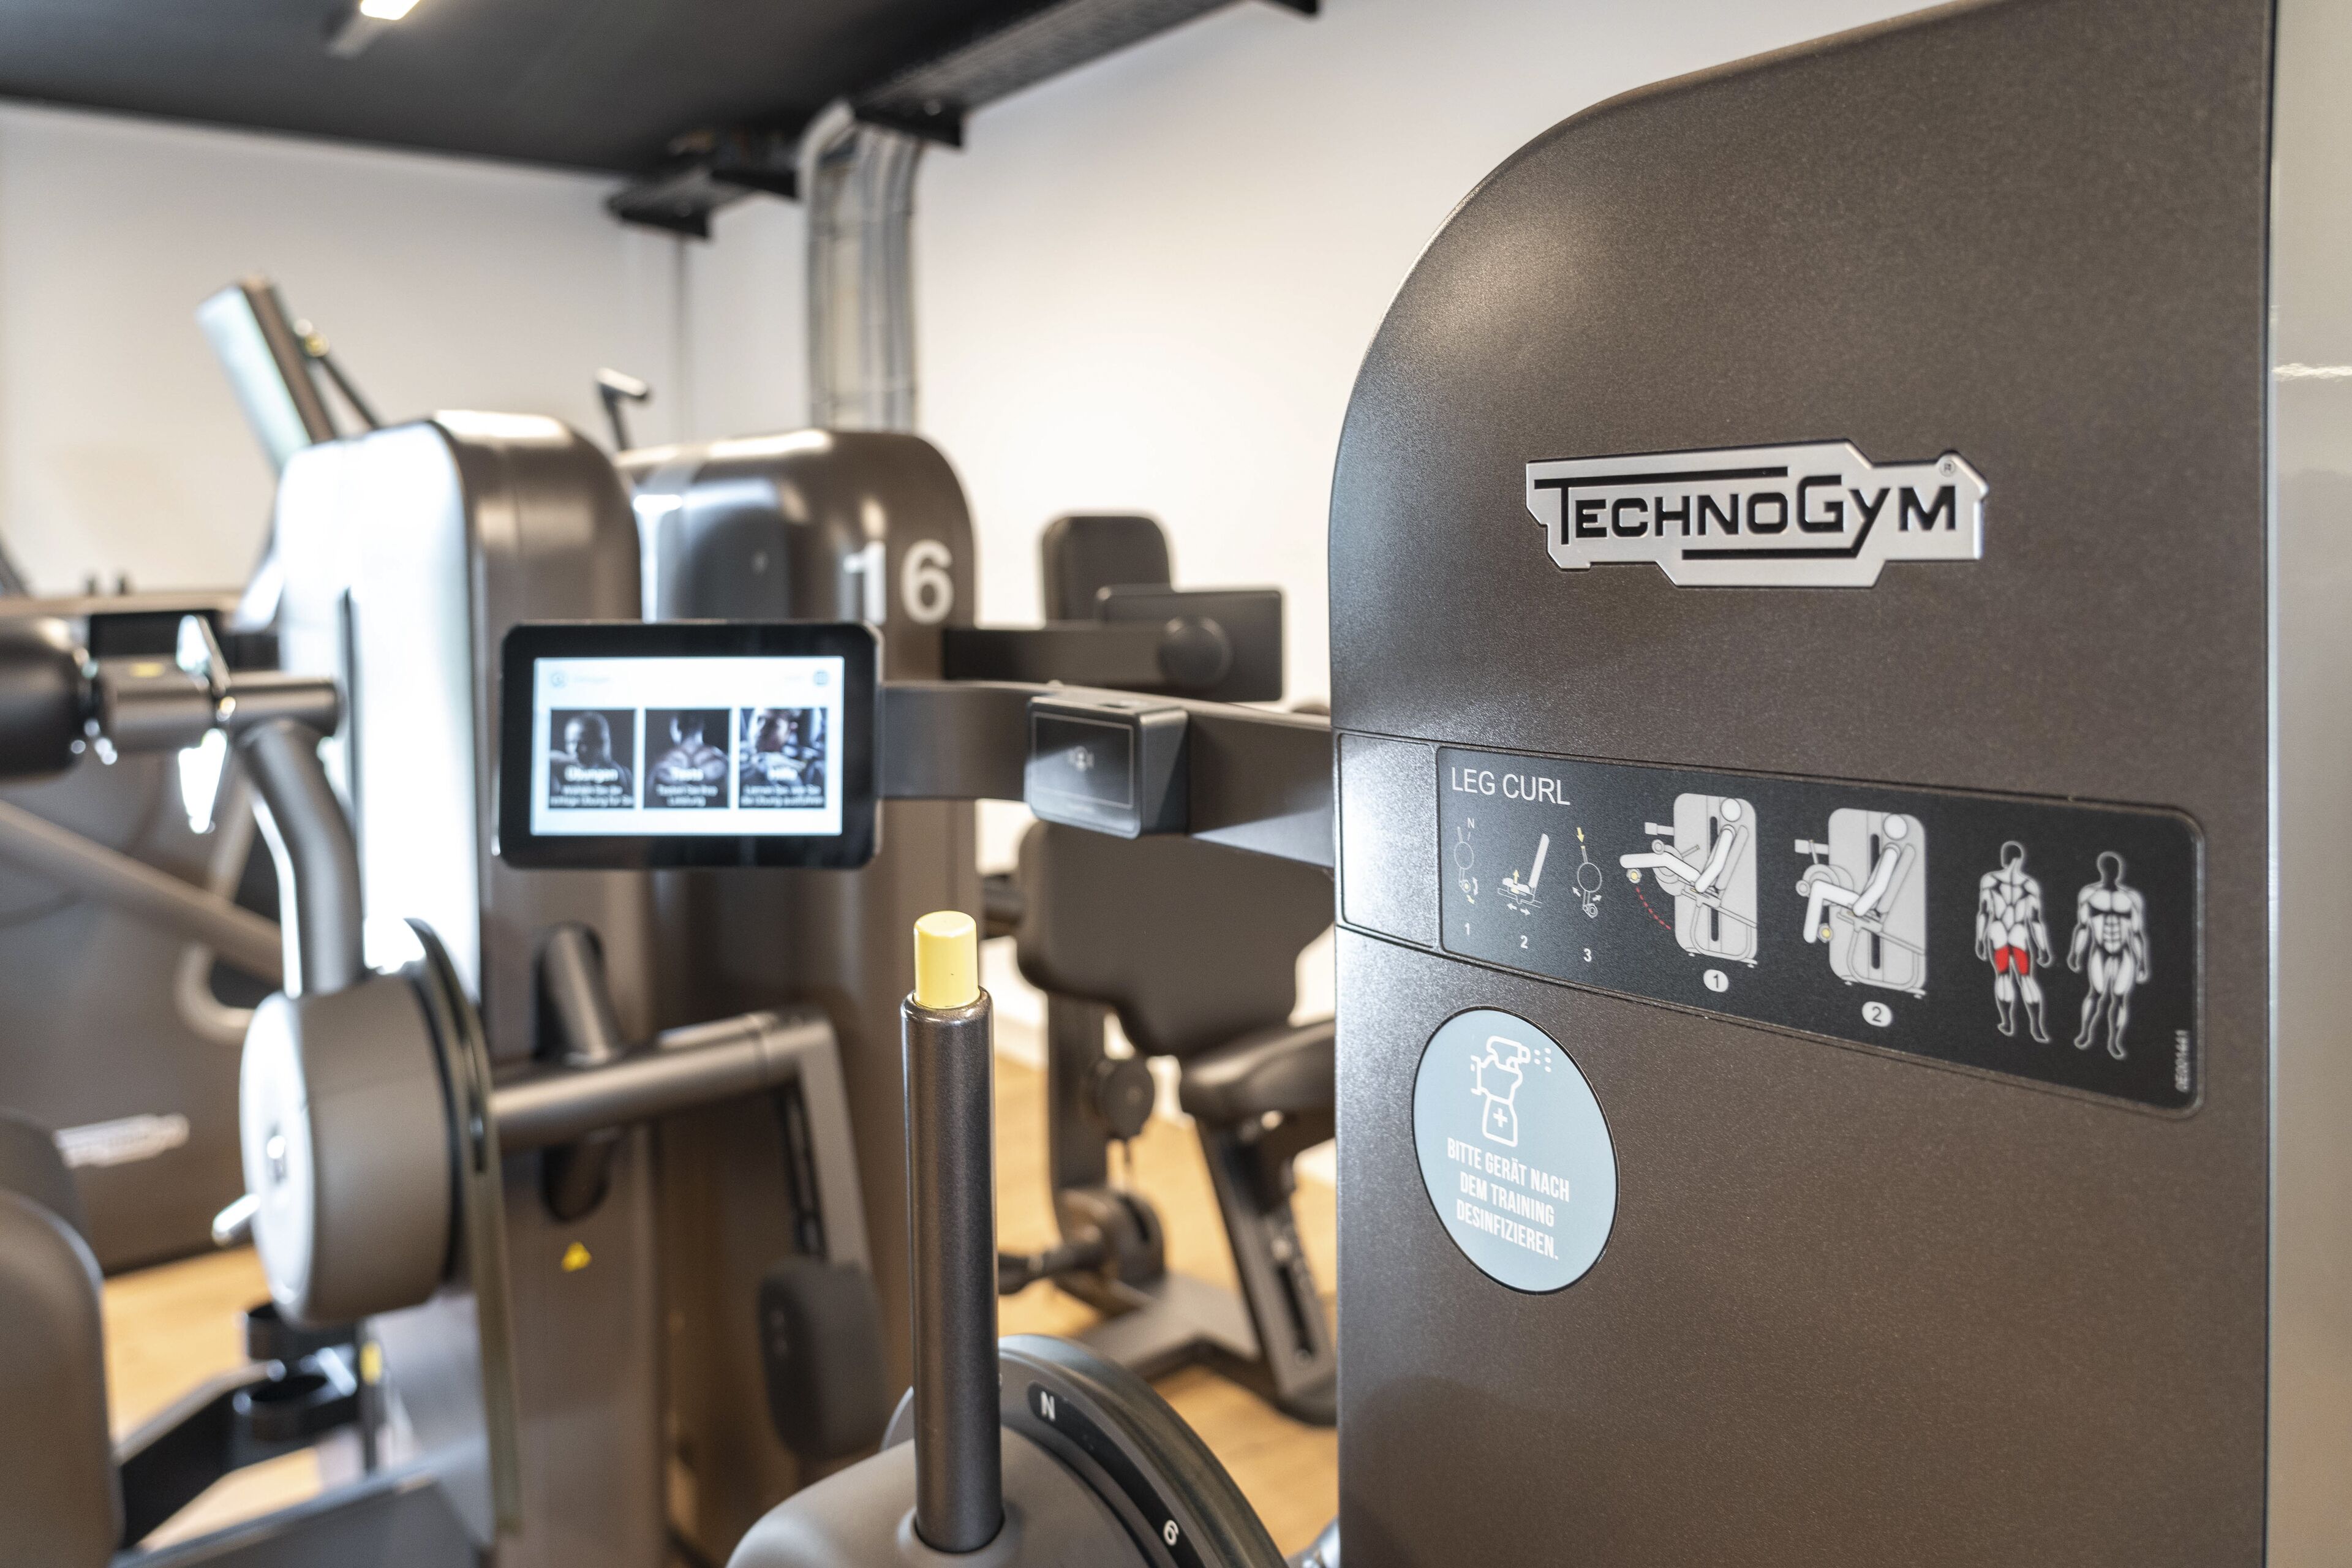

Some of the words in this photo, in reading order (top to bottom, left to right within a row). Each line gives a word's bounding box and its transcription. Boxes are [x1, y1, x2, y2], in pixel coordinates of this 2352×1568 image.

[843, 539, 955, 625] 16
[1452, 767, 1496, 796] LEG
[1502, 774, 1571, 805] CURL
[1468, 817, 1475, 829] N
[1464, 922, 1470, 935] 1
[1520, 935, 1528, 949] 2
[1583, 948, 1592, 962] 3
[1872, 1006, 1882, 1022] 2
[1447, 1137, 1482, 1170] BITTE
[1485, 1151, 1528, 1186] GERÄT
[1531, 1167, 1569, 1203] NACH
[1460, 1170, 1488, 1202] DEM
[1490, 1183, 1555, 1227] TRAINING
[1457, 1198, 1559, 1261] DESINFIZIEREN.
[1041, 1390, 1055, 1421] N
[1164, 1520, 1179, 1546] 6
